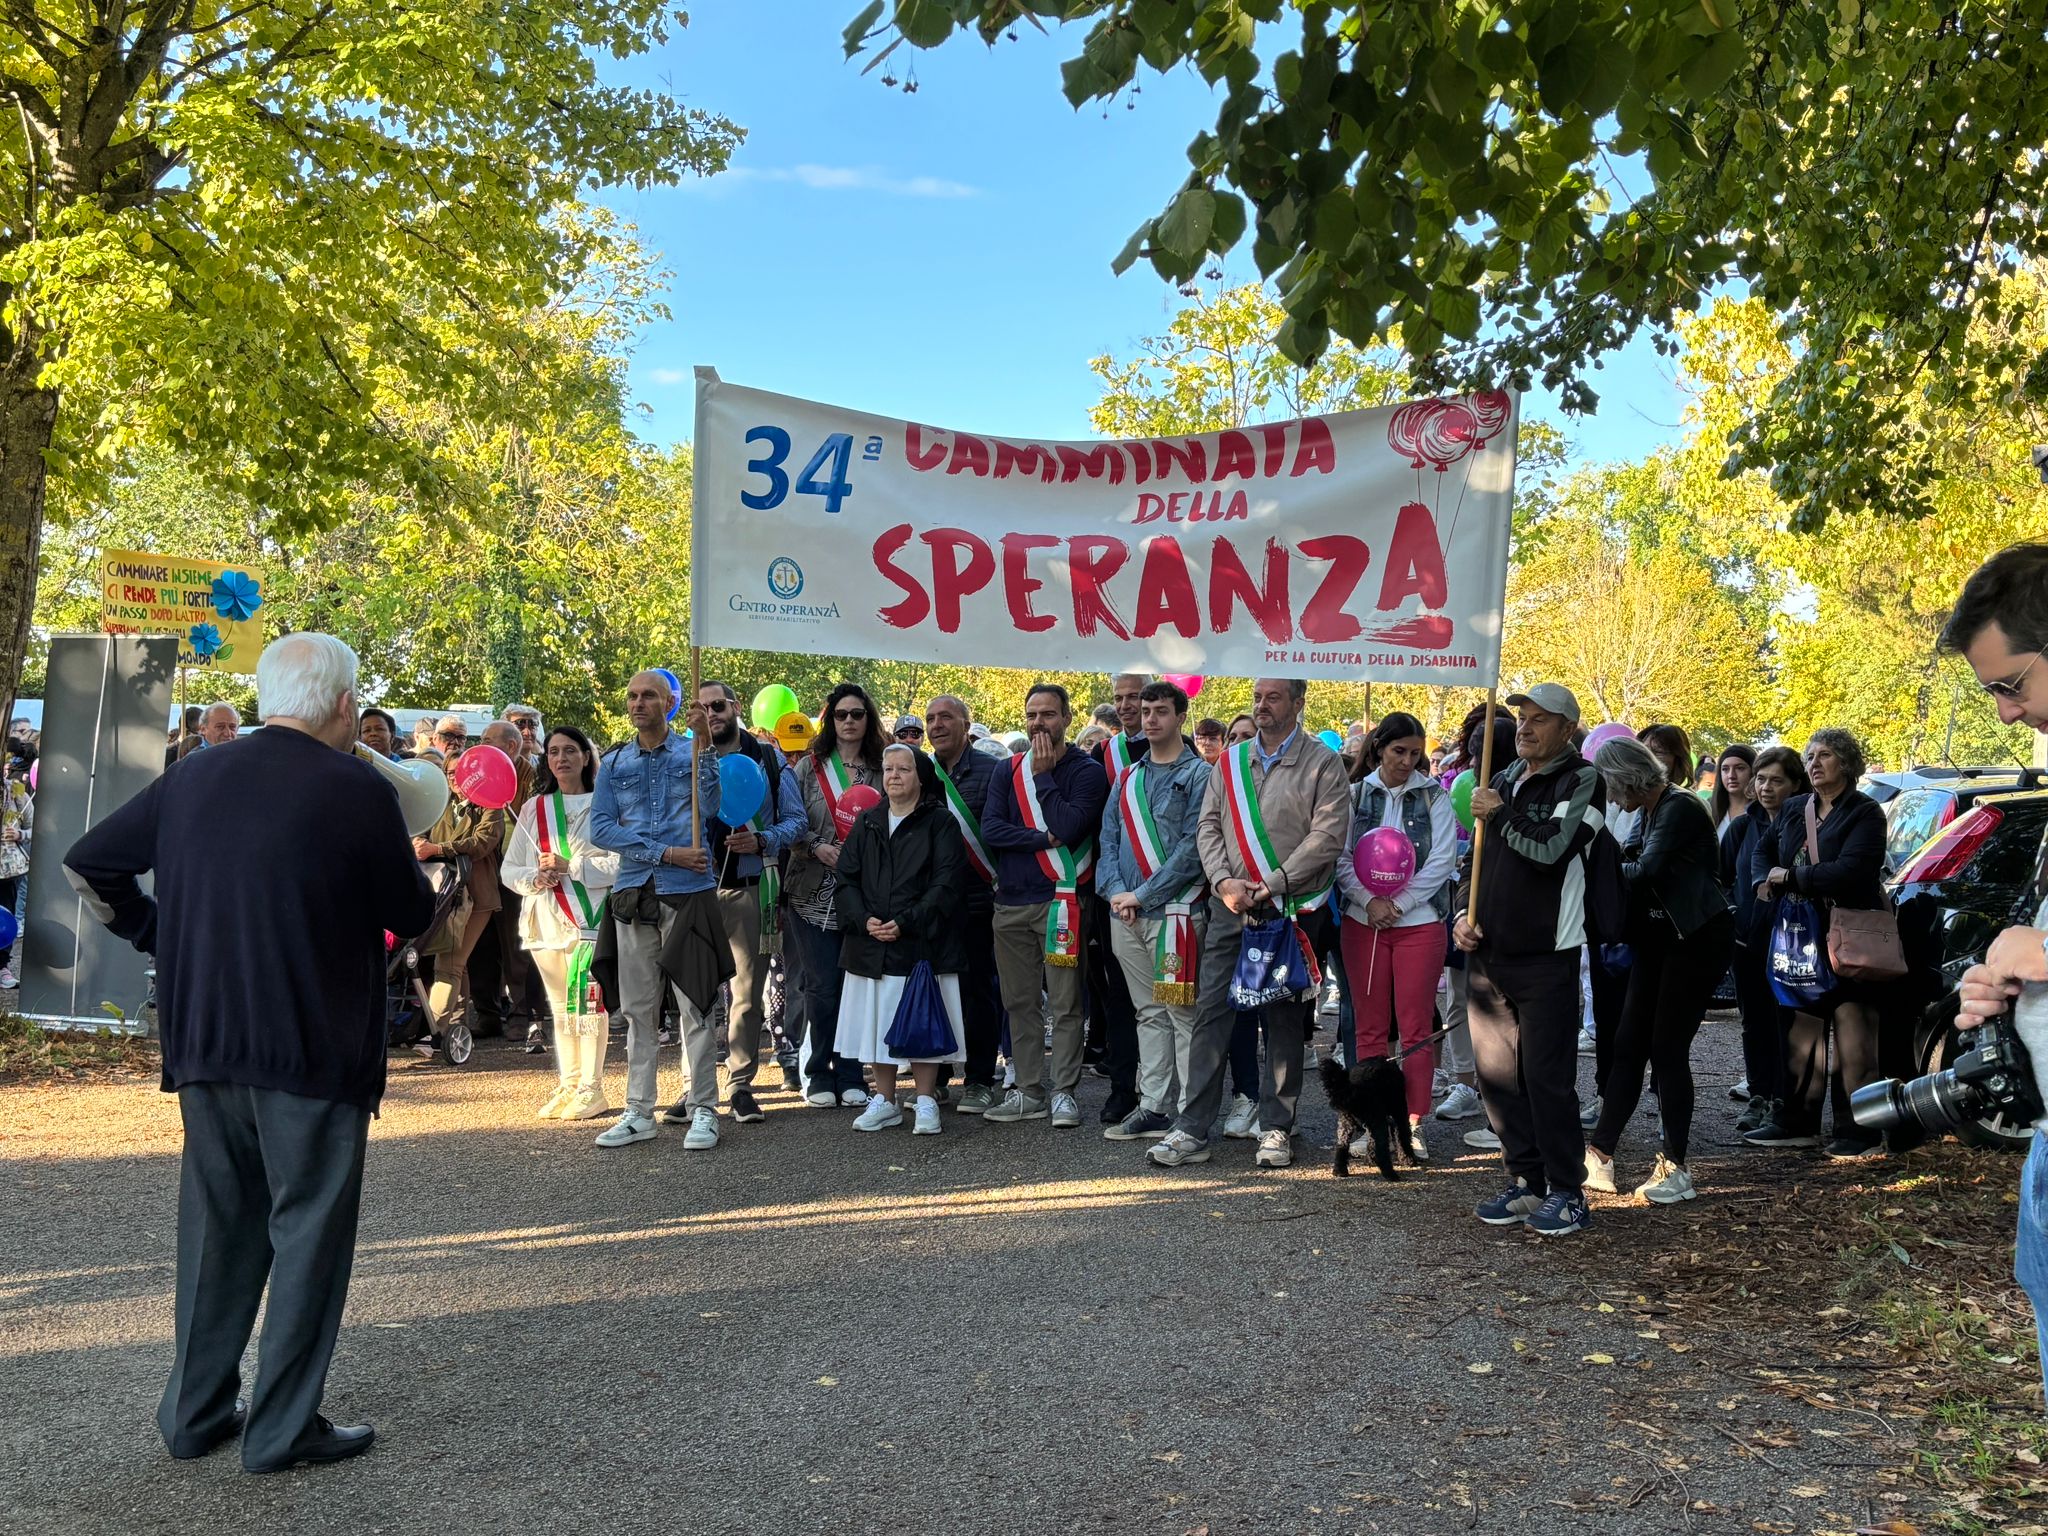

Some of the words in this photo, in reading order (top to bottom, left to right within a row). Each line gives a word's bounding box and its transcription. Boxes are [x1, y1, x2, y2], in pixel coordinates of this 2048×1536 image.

[905, 417, 1336, 485] CAMMINATA
[1131, 490, 1249, 525] DELLA
[106, 561, 168, 583] CAMMINARE
[172, 568, 213, 586] INSIEME
[874, 501, 1454, 650] SPERANZA
[107, 584, 118, 600] CI
[123, 585, 157, 604] RENDE
[161, 586, 179, 605] PIÙ
[105, 603, 118, 617] UN
[120, 605, 148, 620] PASSO
[151, 608, 173, 621] DOPO
[177, 651, 211, 666] MONDO
[1265, 650, 1288, 663] PER
[1292, 651, 1306, 663] LA
[1310, 652, 1362, 665] CULTURA
[1368, 653, 1405, 666] DELLA
[1410, 653, 1477, 668] DISABILITÀ
